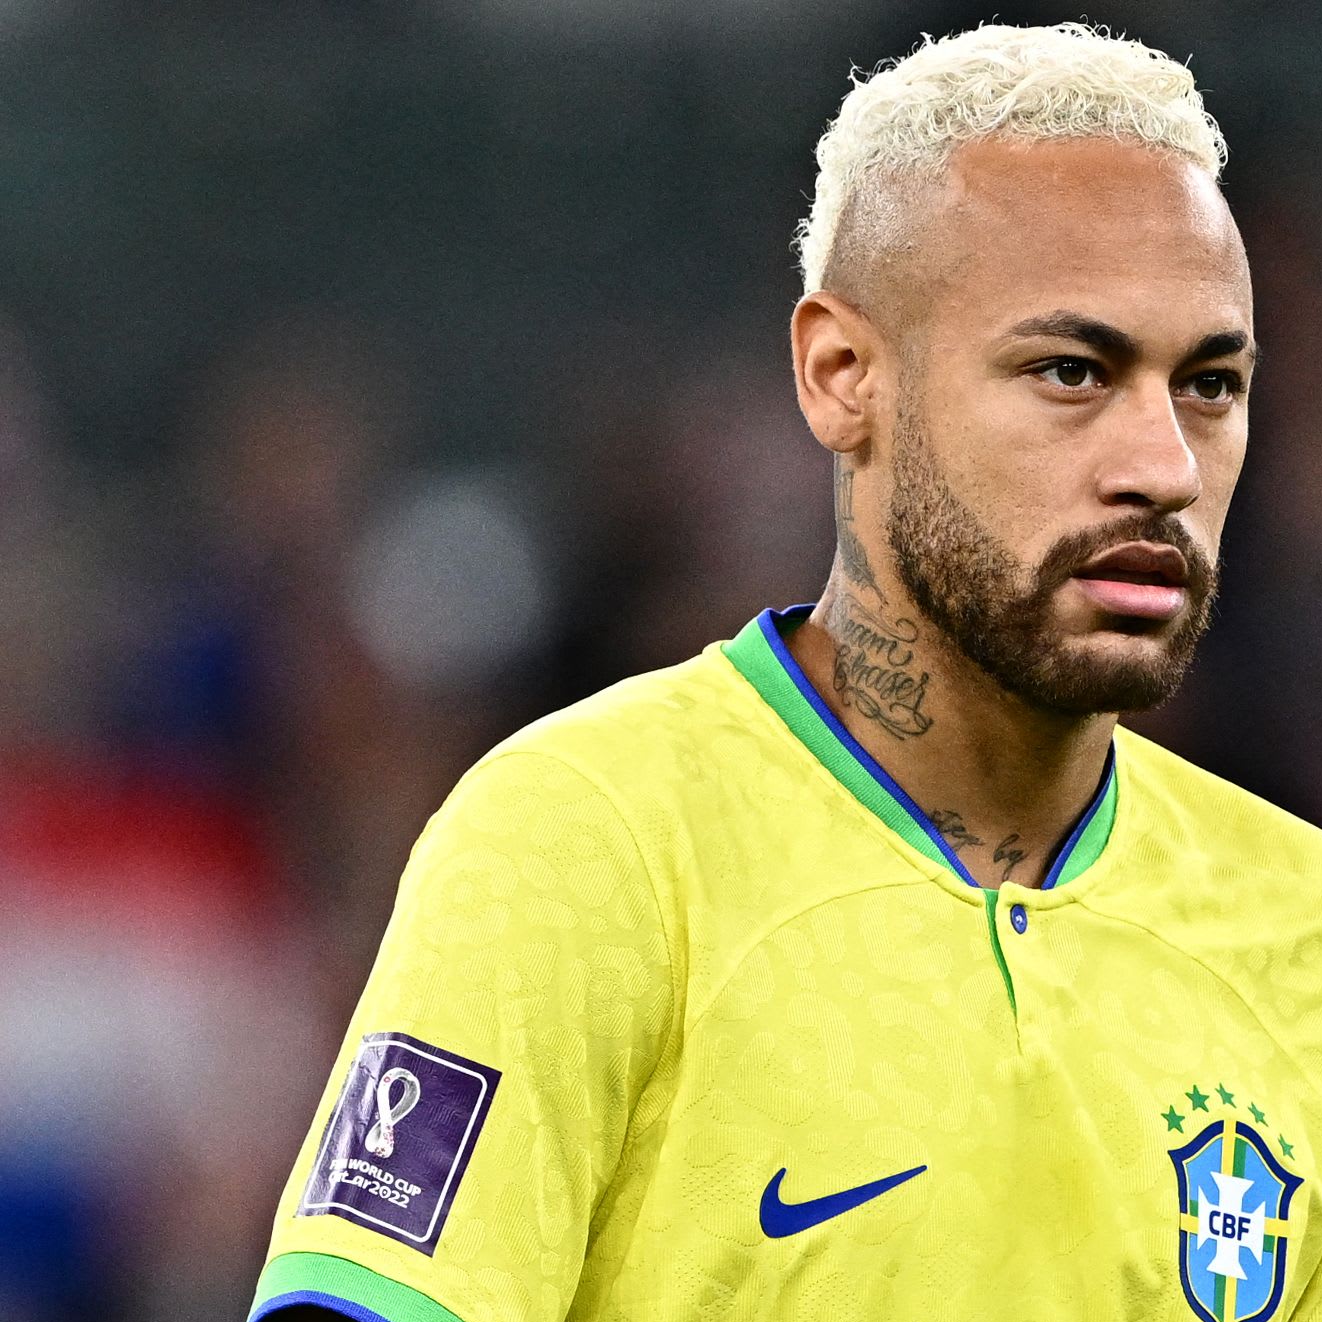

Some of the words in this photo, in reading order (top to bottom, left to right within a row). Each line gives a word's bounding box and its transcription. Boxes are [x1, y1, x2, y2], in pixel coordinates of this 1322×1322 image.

[348, 1159, 394, 1184] WORLD
[394, 1178, 422, 1196] CUP
[1209, 1210, 1251, 1241] CBF
